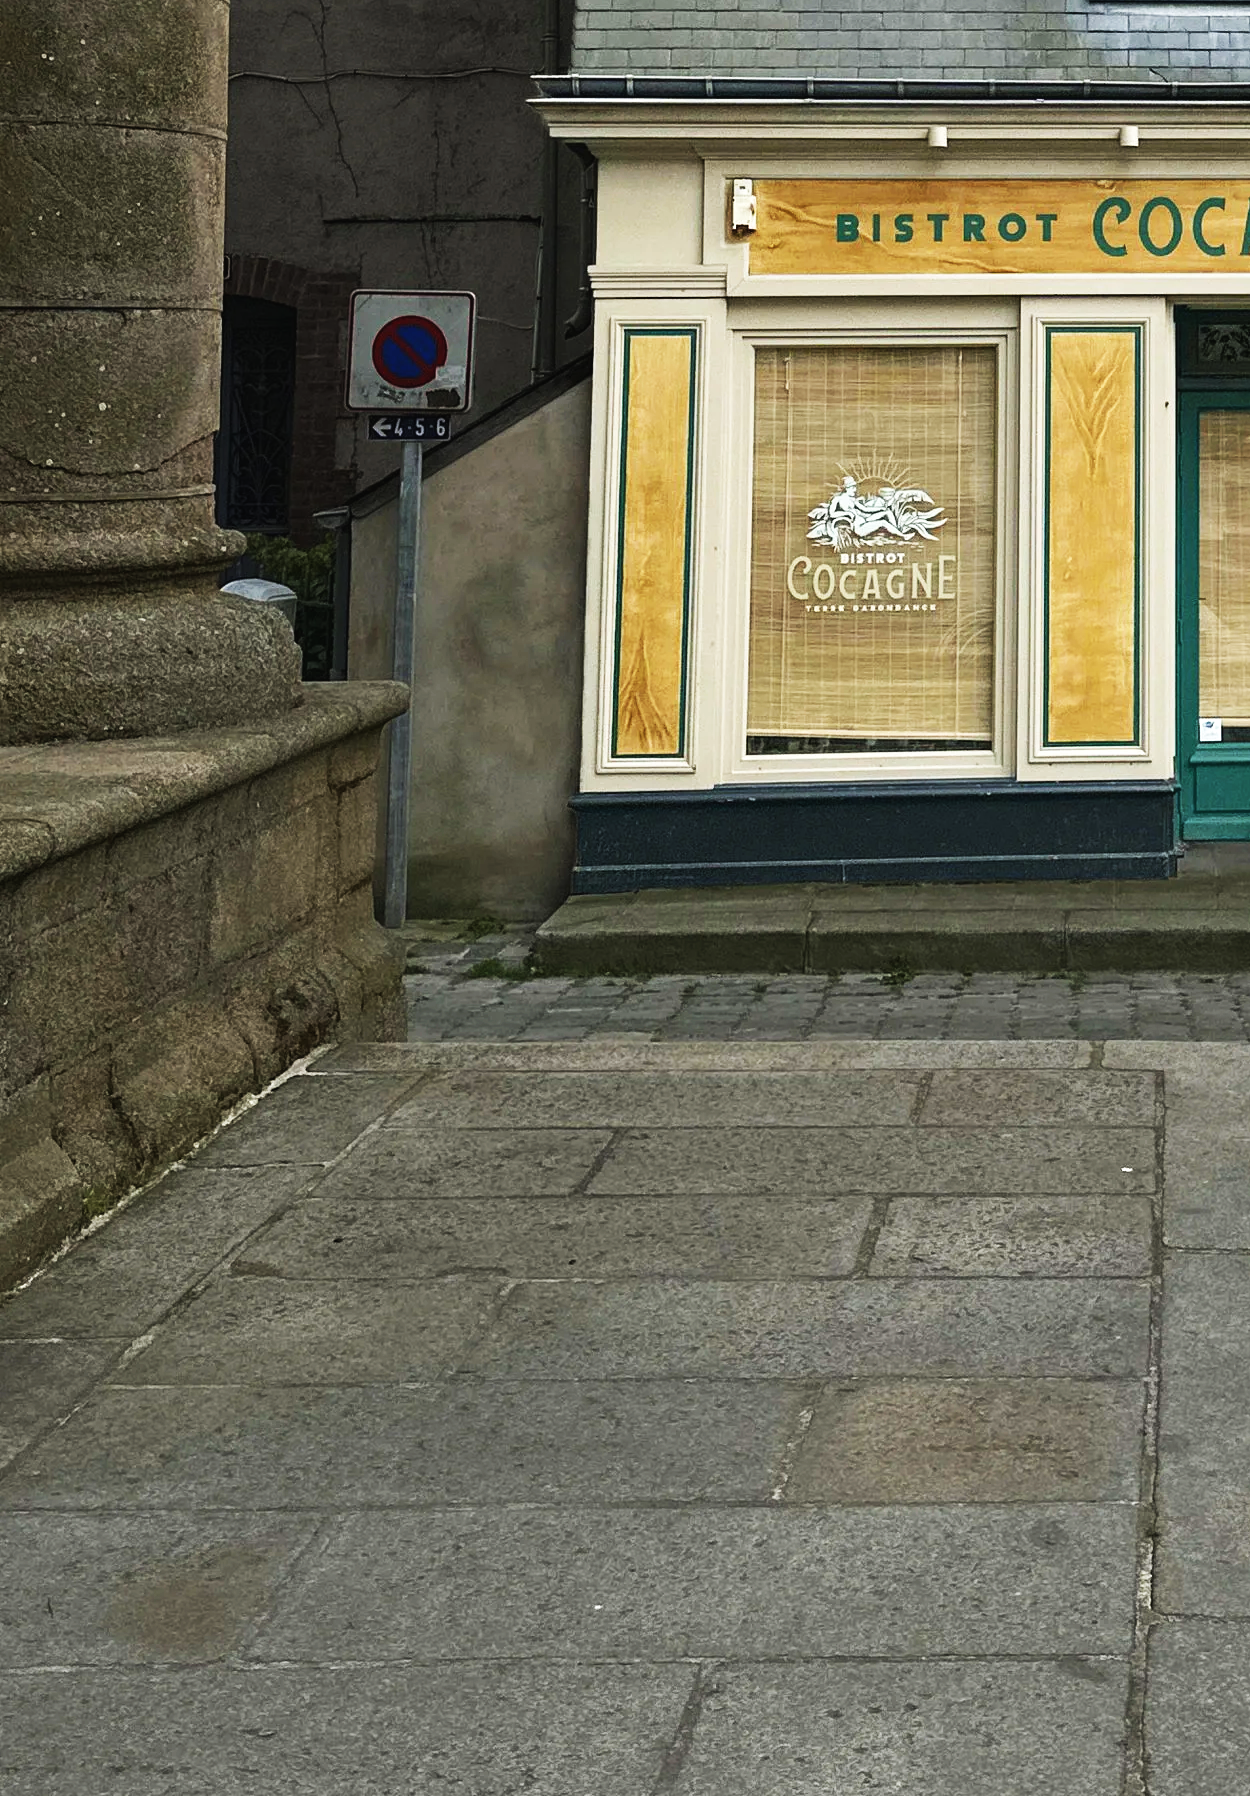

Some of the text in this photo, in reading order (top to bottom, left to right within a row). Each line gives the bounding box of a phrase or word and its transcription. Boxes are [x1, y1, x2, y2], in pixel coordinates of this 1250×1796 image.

[836, 213, 1059, 242] BISTROT
[840, 553, 905, 564] BISTROT
[787, 555, 956, 600] COCAGNE
